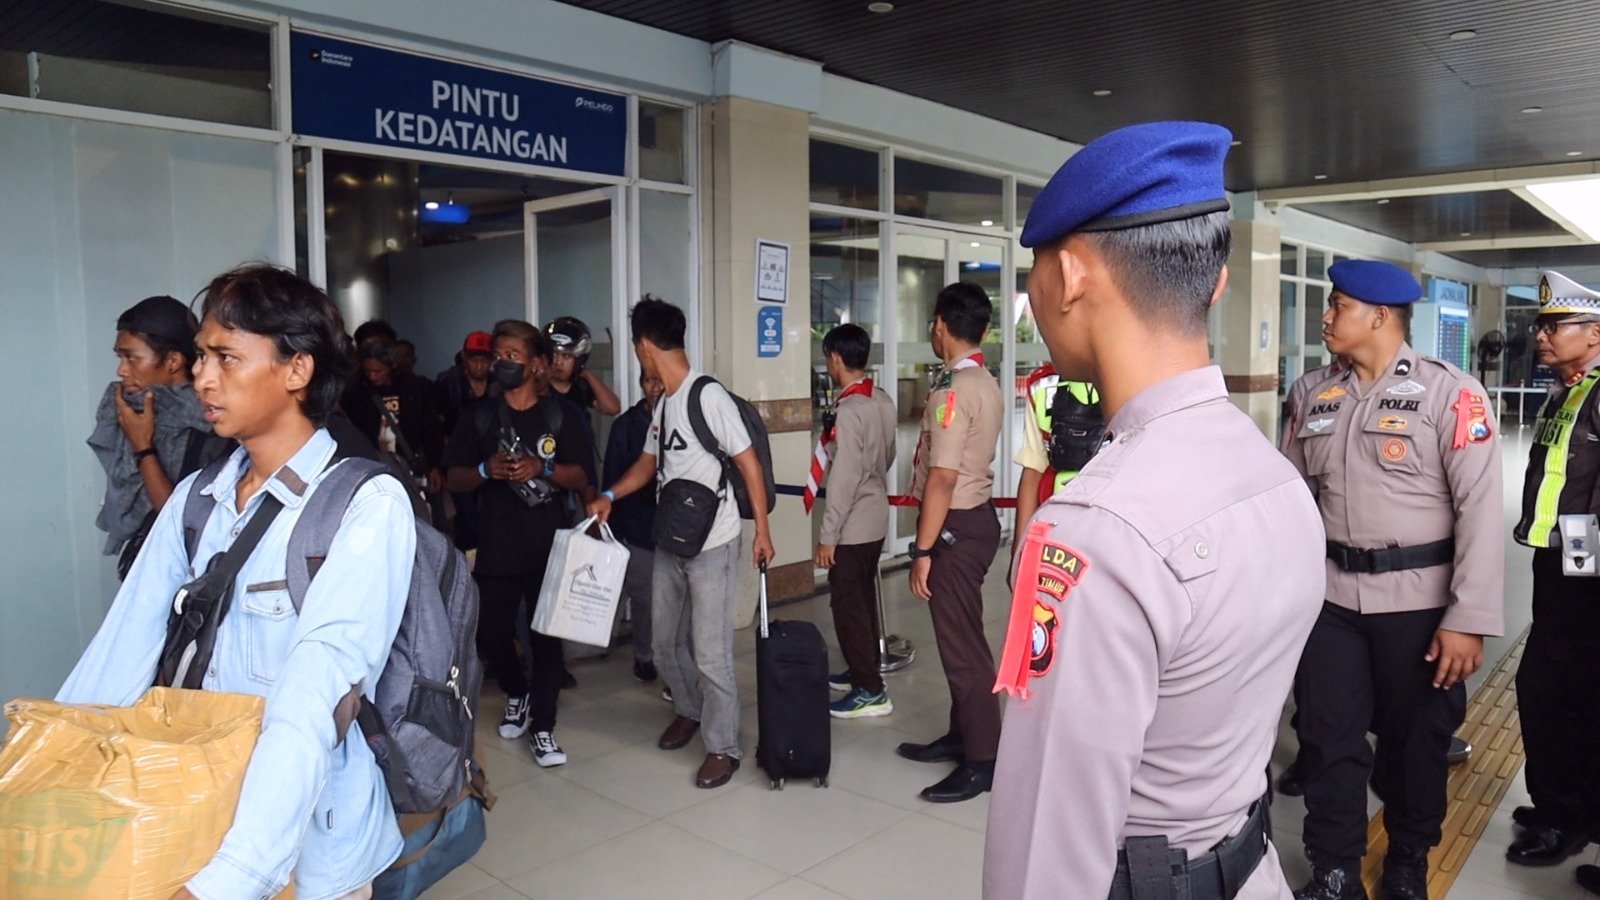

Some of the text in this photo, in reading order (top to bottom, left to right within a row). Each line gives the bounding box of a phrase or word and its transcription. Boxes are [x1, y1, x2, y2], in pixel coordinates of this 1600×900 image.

[431, 80, 519, 122] PINTU
[375, 108, 567, 164] KEDATANGAN
[1308, 402, 1341, 417] ANAS
[1379, 398, 1422, 412] POLRI
[1042, 546, 1078, 573] LDA
